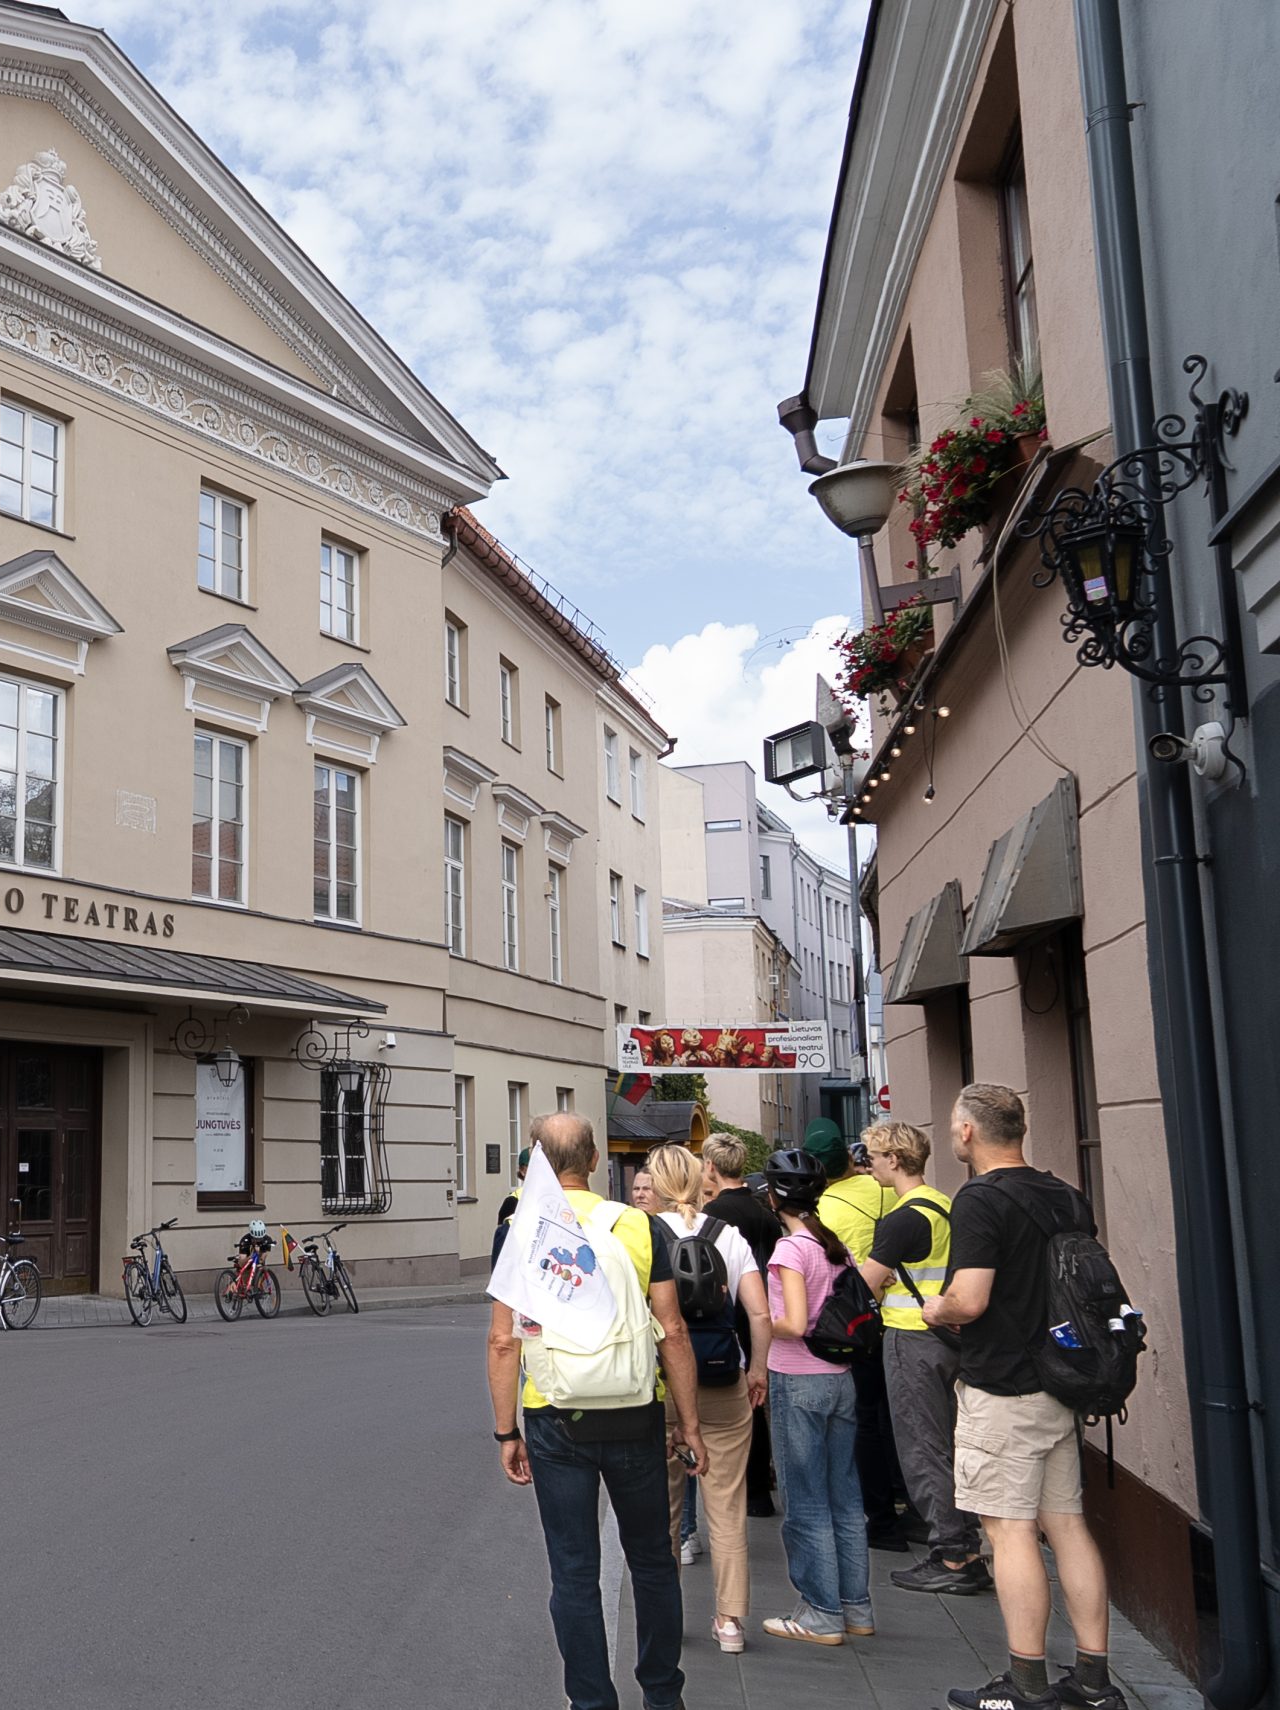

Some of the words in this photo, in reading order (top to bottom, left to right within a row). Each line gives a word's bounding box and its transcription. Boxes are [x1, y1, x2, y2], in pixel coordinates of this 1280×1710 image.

[41, 892, 176, 938] TEATRAS
[767, 1035, 823, 1043] profesionaliam
[798, 1053, 825, 1068] 90
[196, 1118, 241, 1130] JUNGTUVĖS
[979, 1699, 1015, 1710] HOKA
